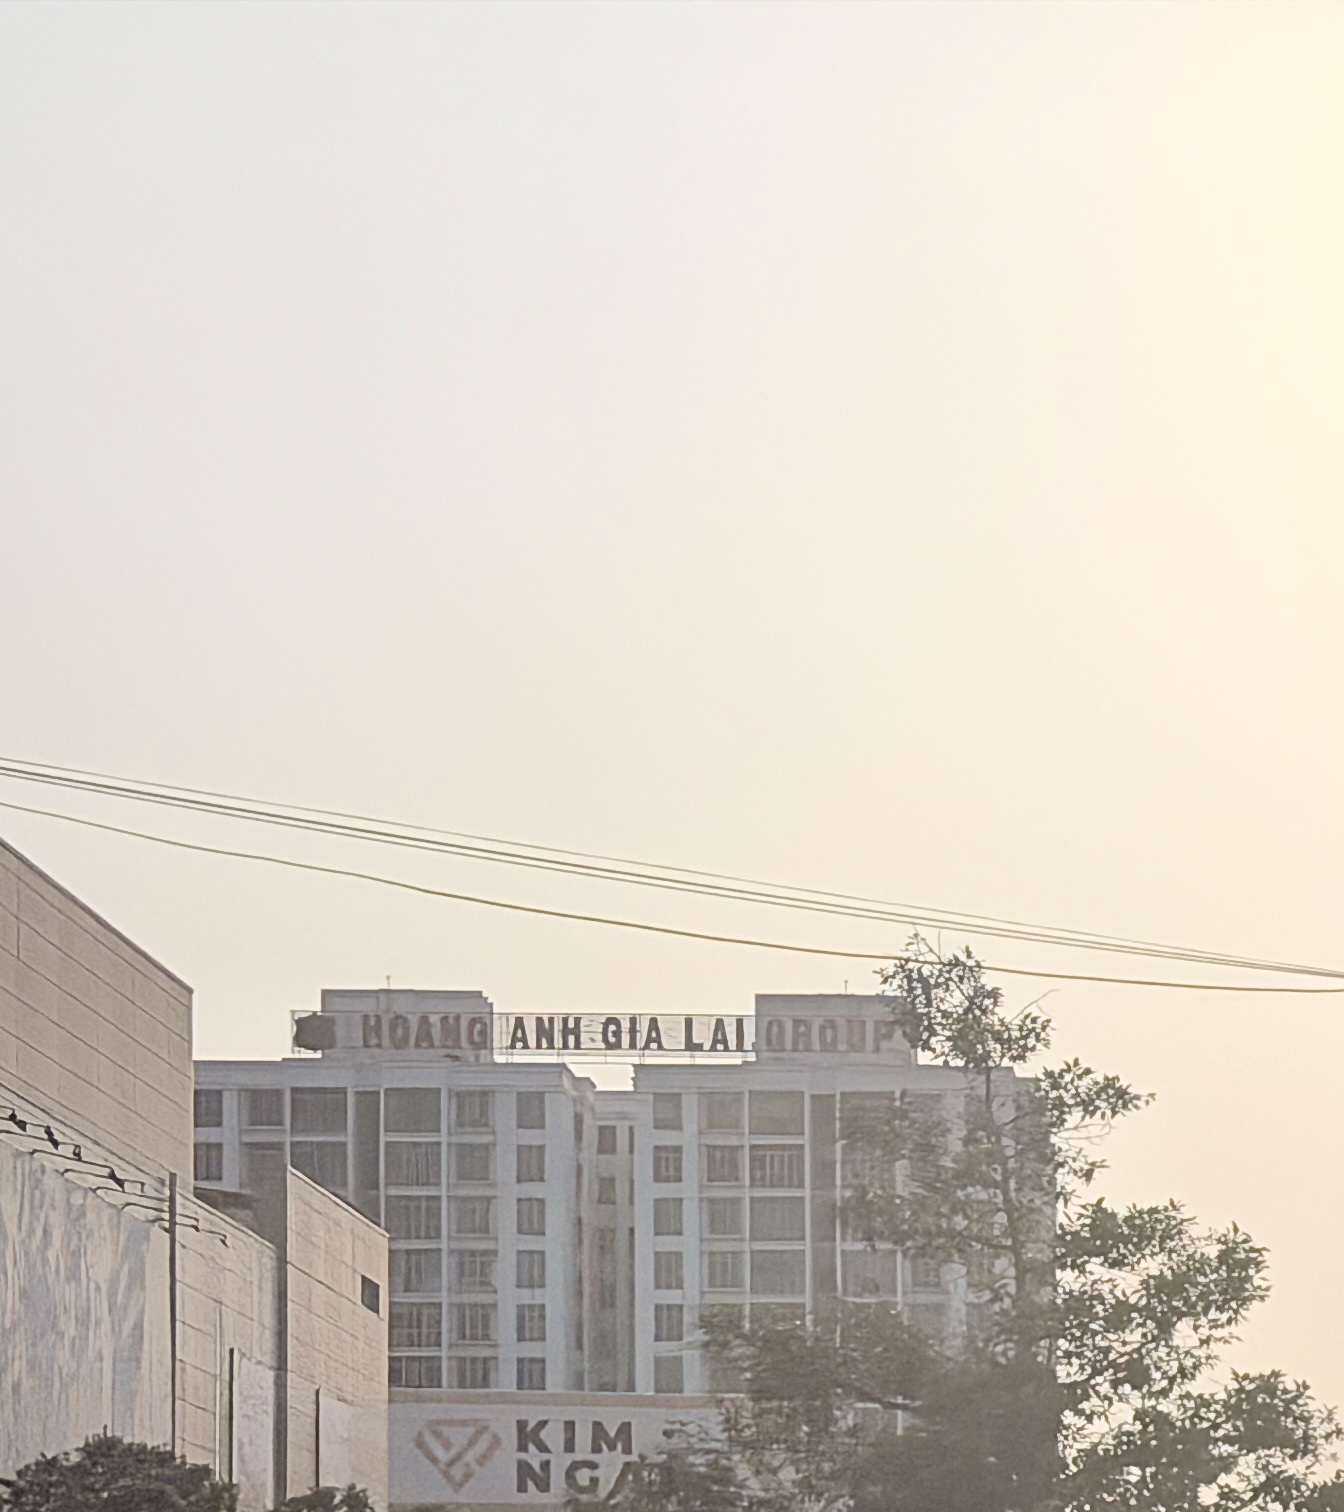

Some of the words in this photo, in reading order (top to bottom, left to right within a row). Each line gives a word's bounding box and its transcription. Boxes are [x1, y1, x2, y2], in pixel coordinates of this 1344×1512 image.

[510, 1016, 581, 1050] ANH
[602, 1016, 664, 1050] GIA
[684, 1017, 744, 1050] LAI
[516, 1419, 633, 1455] KIM
